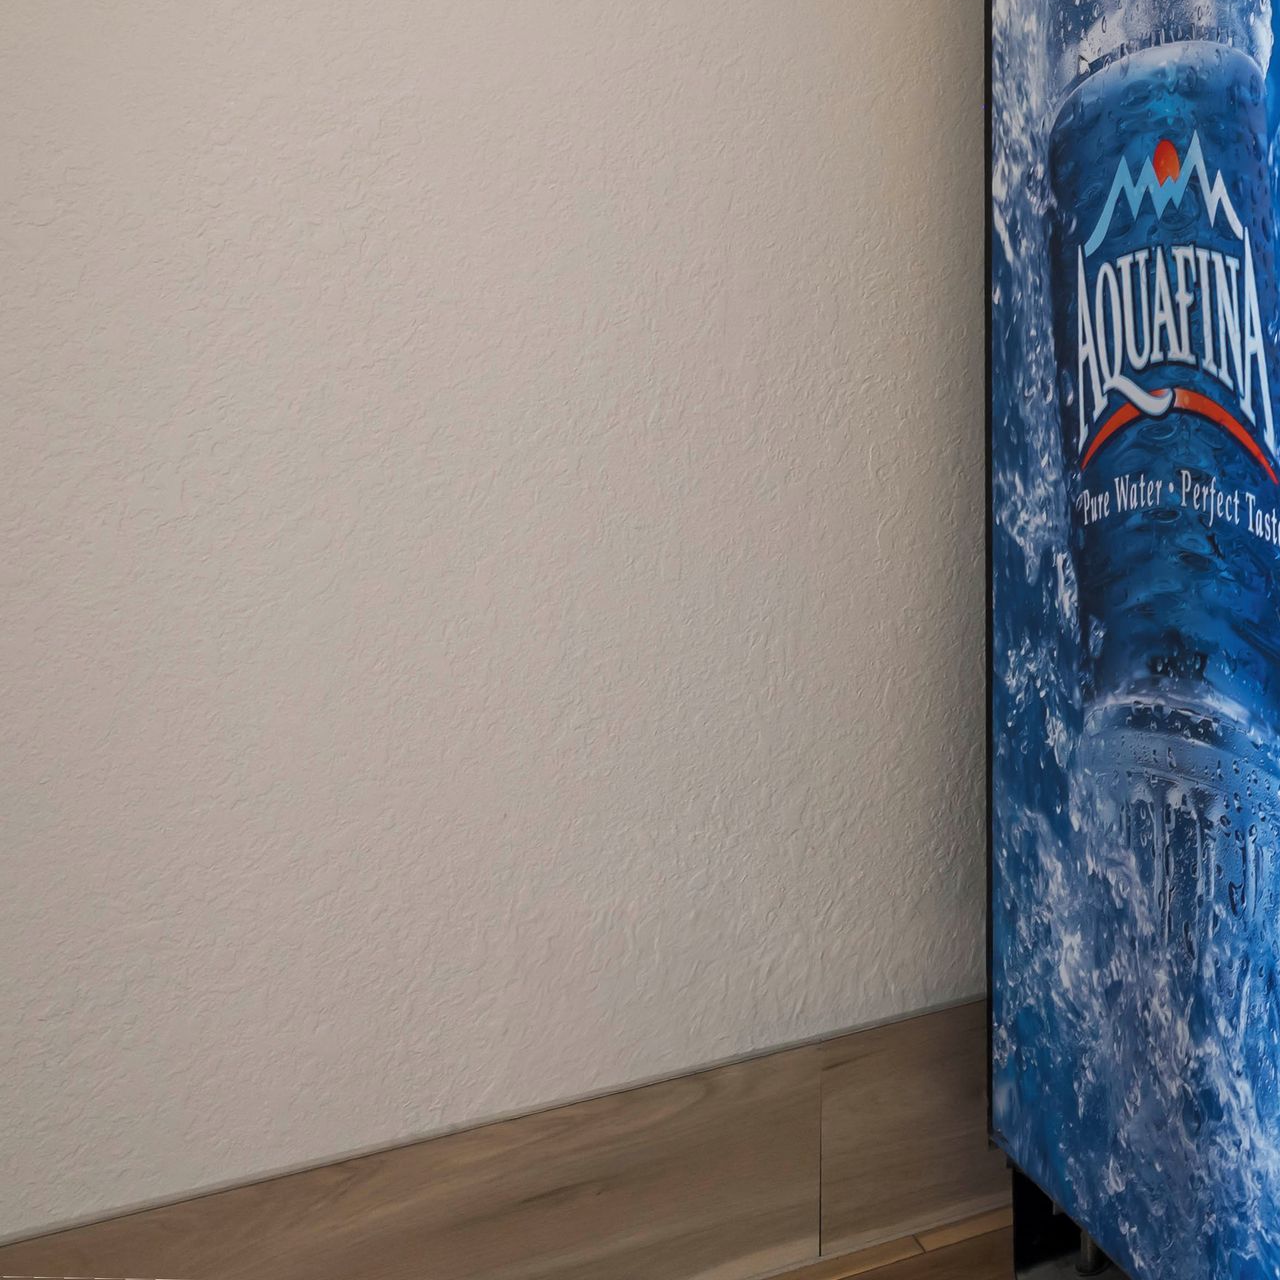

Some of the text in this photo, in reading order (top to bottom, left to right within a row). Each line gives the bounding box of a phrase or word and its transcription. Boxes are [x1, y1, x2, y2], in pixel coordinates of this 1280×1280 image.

[1077, 226, 1277, 456] AQUAFINA
[1082, 489, 1110, 526] Pure
[1114, 473, 1164, 514] Water
[1181, 469, 1242, 527] Perfect
